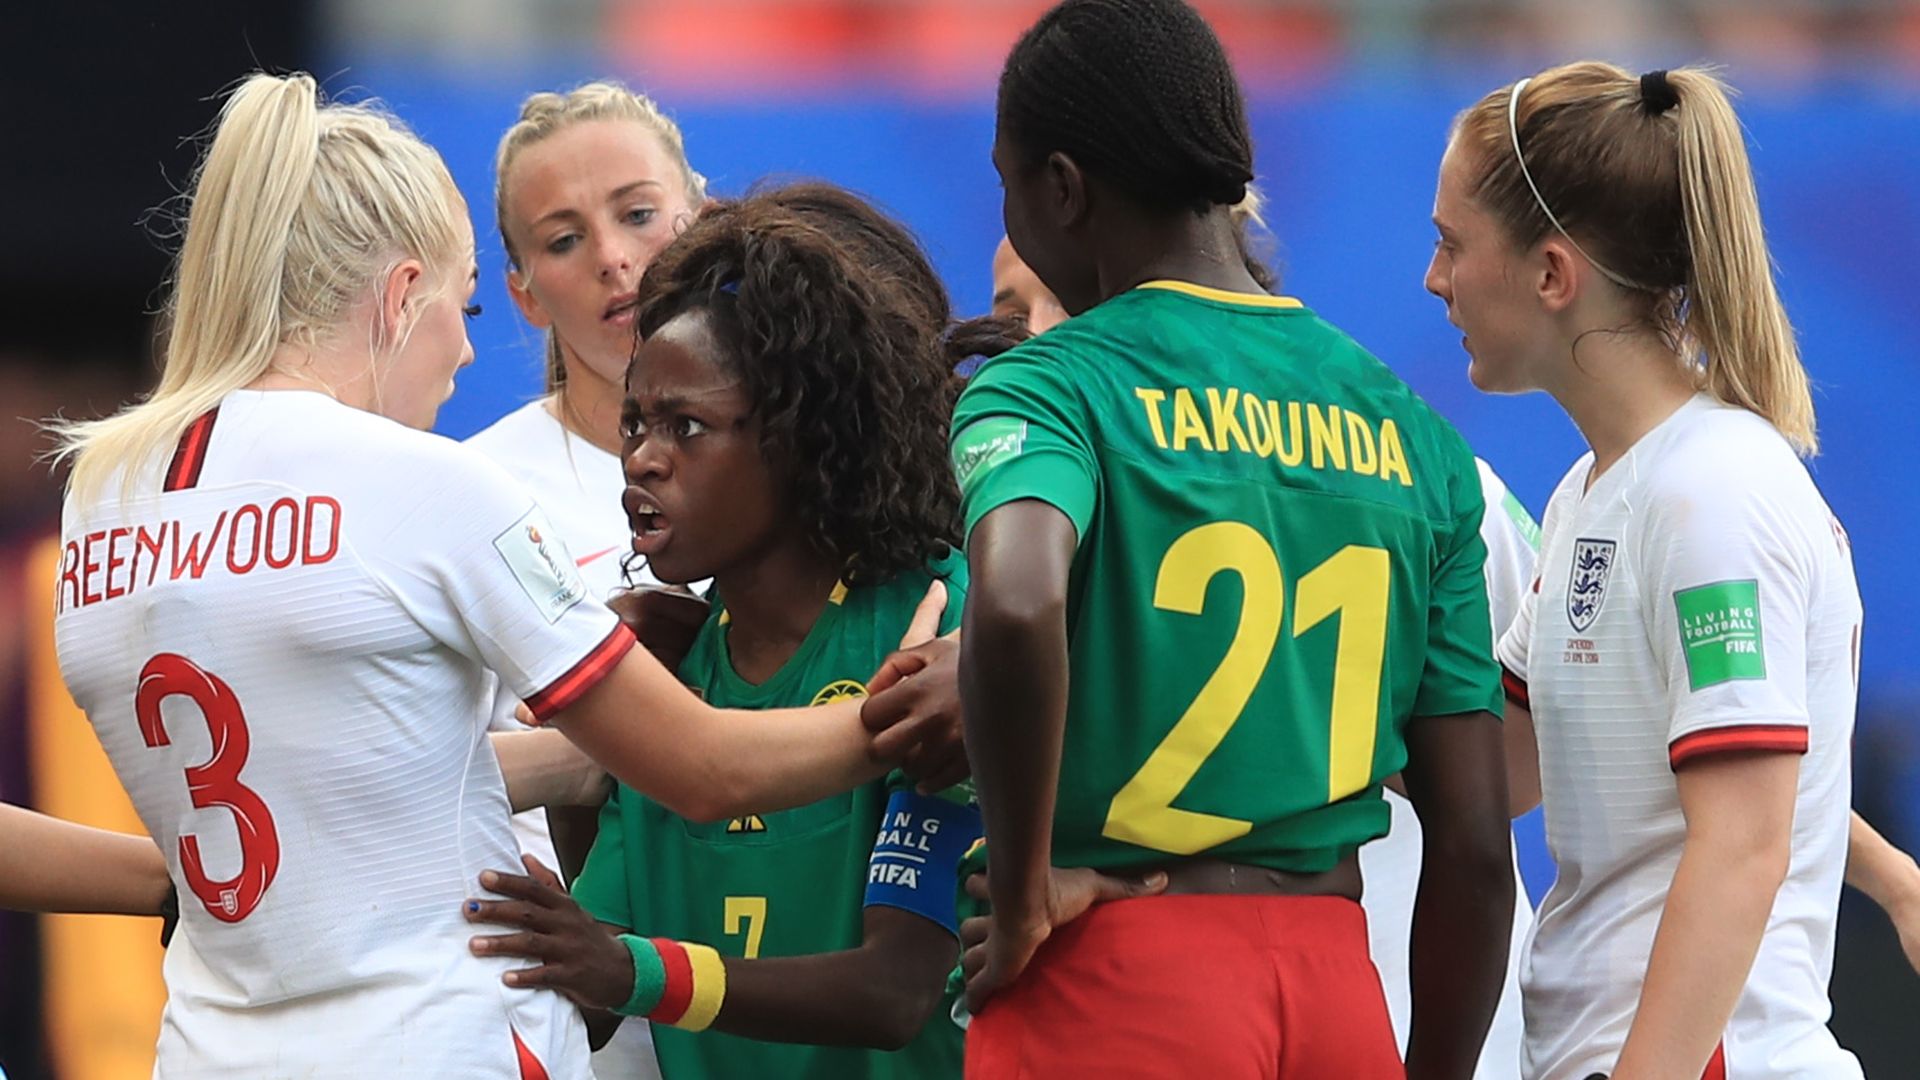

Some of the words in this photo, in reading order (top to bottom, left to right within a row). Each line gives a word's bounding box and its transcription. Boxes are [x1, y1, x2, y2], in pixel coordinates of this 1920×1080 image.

[1135, 386, 1414, 487] TAKOUNDA
[55, 495, 342, 615] REENWOOD
[1683, 607, 1754, 629] LIVING
[1685, 618, 1755, 640] FOOTBALL
[1725, 640, 1758, 654] FIFA
[1101, 520, 1391, 856] 21
[135, 652, 280, 924] 3
[875, 829, 931, 852] BALL
[868, 863, 918, 890] FIFA
[723, 896, 767, 960] 7
